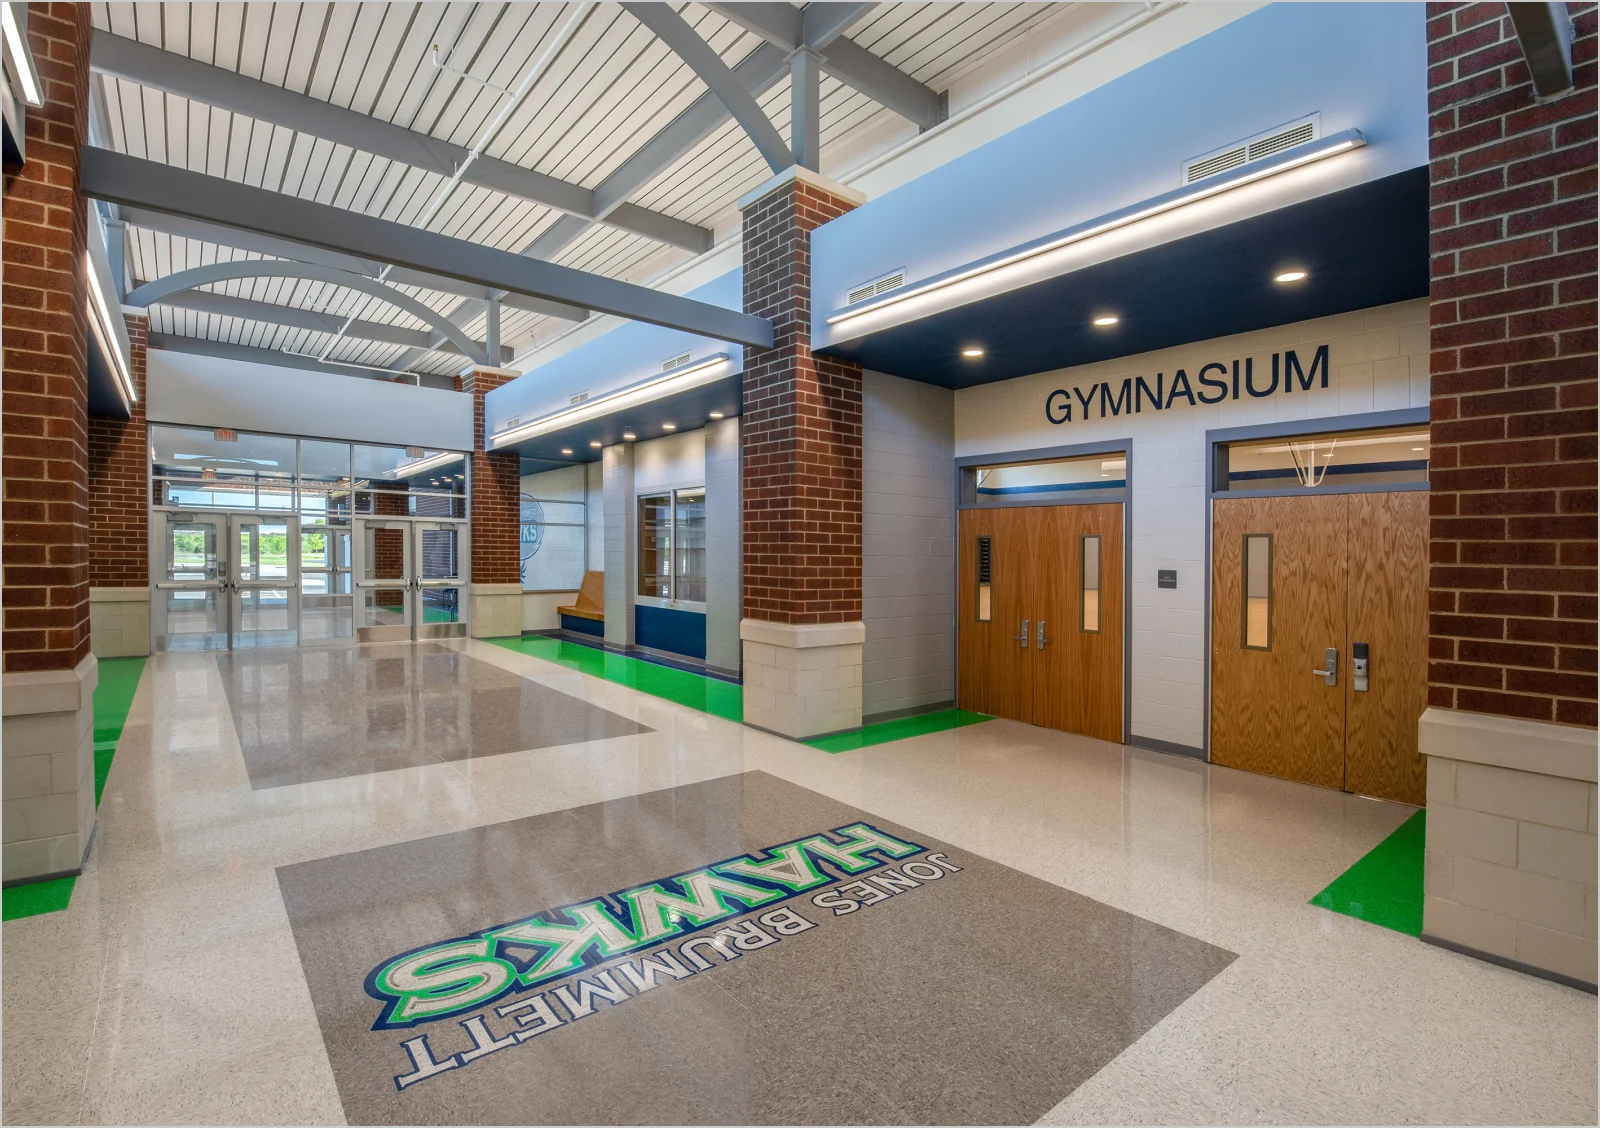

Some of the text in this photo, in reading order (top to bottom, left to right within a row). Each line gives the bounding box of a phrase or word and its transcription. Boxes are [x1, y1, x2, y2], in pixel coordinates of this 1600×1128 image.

[1045, 344, 1329, 425] GYMNASIUM
[363, 821, 931, 1031] HAWKS
[393, 852, 964, 1091] JONES BRUMMETT
